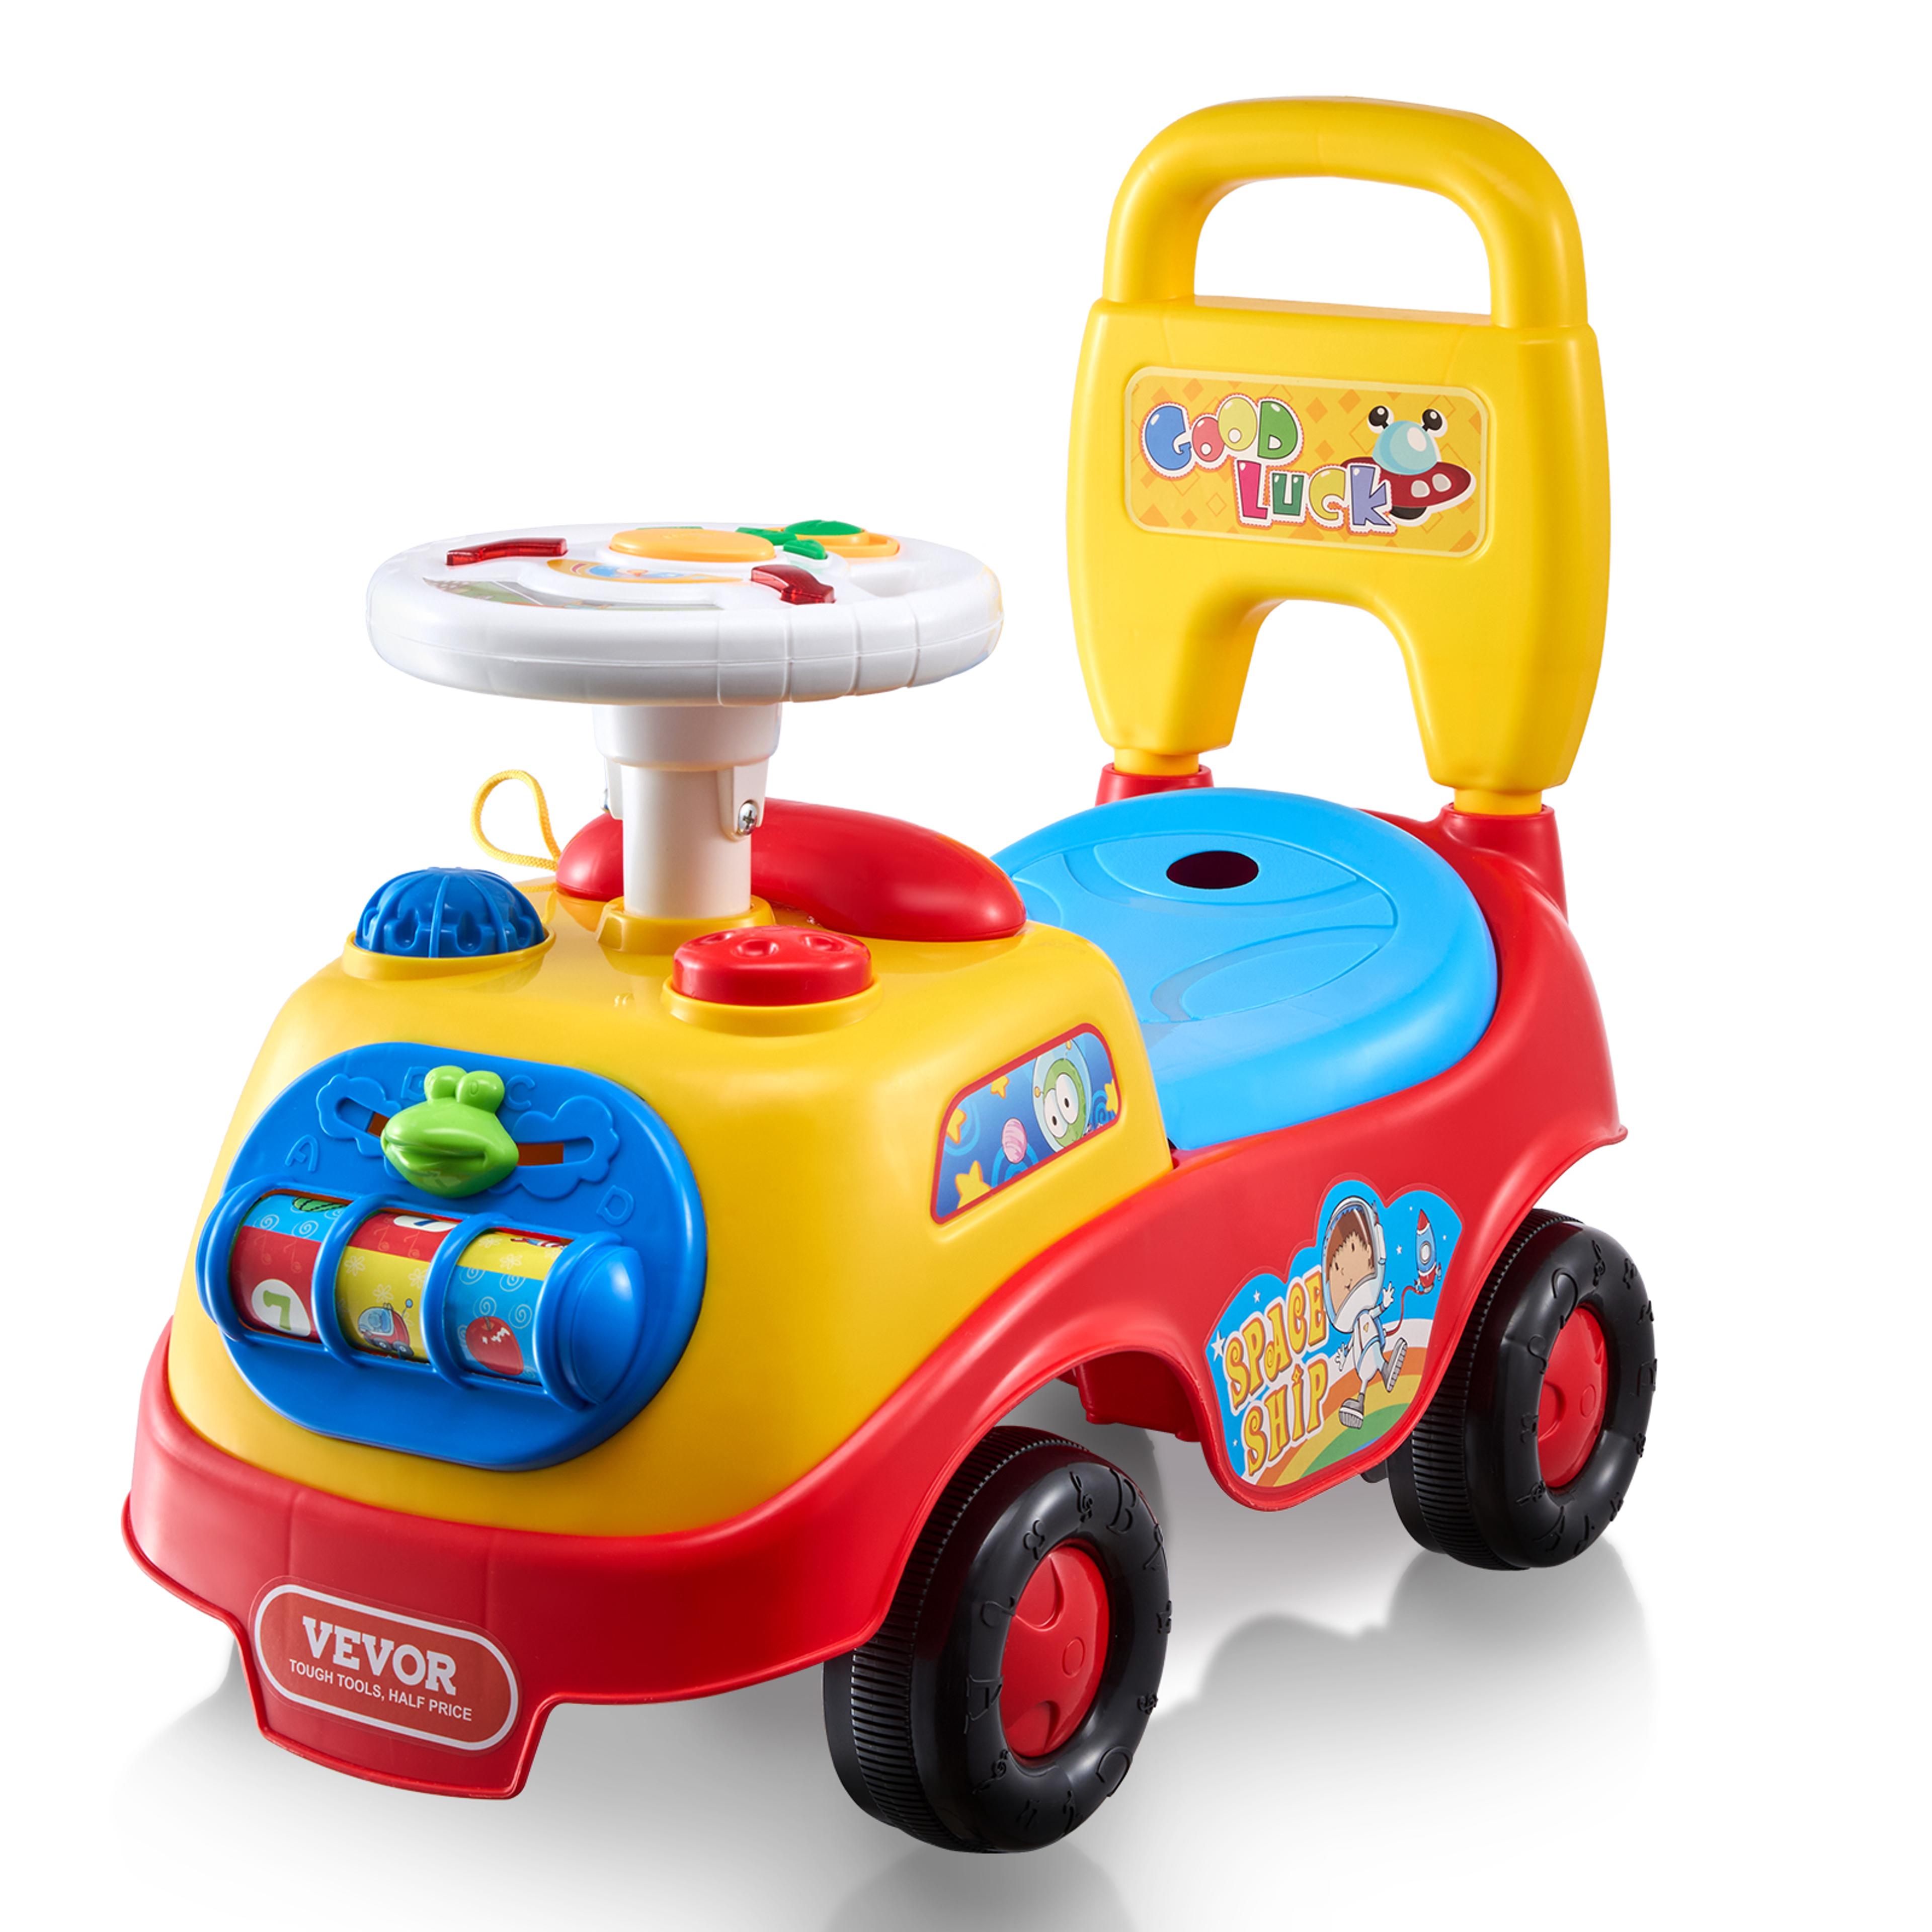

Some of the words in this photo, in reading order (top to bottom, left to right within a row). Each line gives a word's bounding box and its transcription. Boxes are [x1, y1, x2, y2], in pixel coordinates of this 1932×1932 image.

[1144, 396, 1299, 471] GOOD
[1236, 459, 1392, 526] LUCK
[285, 1134, 319, 1173] A
[505, 1074, 536, 1111] C
[595, 1184, 635, 1227] D
[262, 1289, 292, 1331] 7
[1225, 1270, 1326, 1410] SPACE
[289, 1658, 334, 1684] TOUGH
[337, 1673, 385, 1702] TOOLS,
[388, 1688, 425, 1709] HALF
[429, 1699, 472, 1722] PRICE
[302, 1616, 456, 1696] VEVOR
